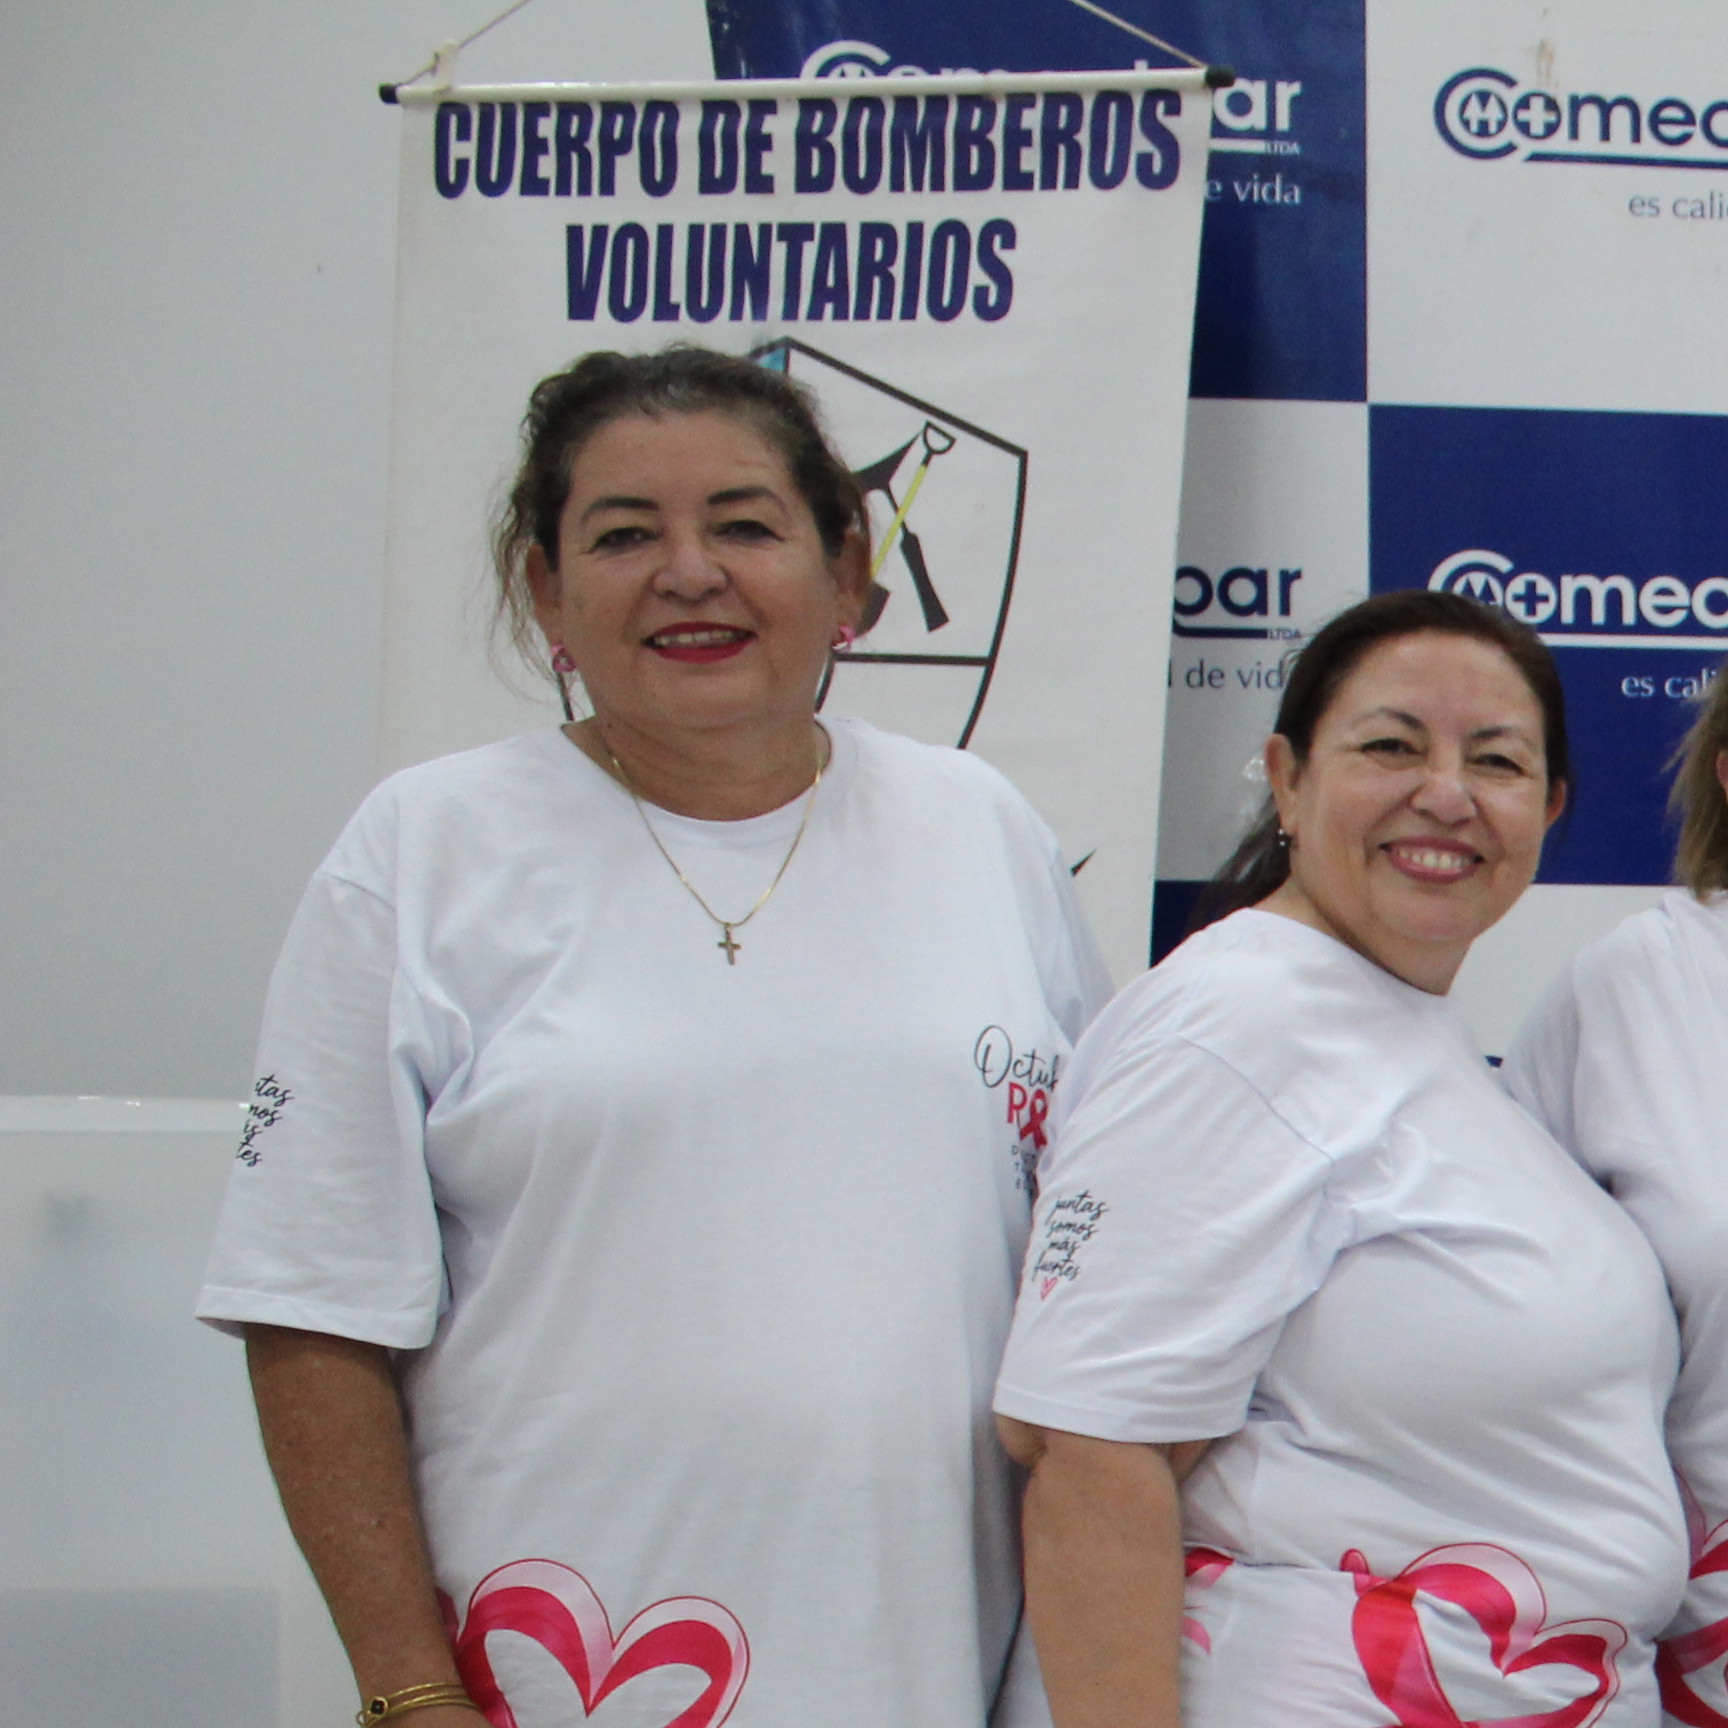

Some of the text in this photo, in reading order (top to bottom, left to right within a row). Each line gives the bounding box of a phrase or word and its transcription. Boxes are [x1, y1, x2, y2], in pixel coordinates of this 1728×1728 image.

[433, 99, 680, 199] CUERPO
[697, 98, 779, 196] DE
[793, 89, 1186, 195] BOMBEROS
[1233, 173, 1300, 204] vida
[1629, 196, 1661, 217] es
[565, 217, 1019, 324] VOLUNTARIOS
[1185, 659, 1284, 689] de vid
[1620, 675, 1656, 698] es
